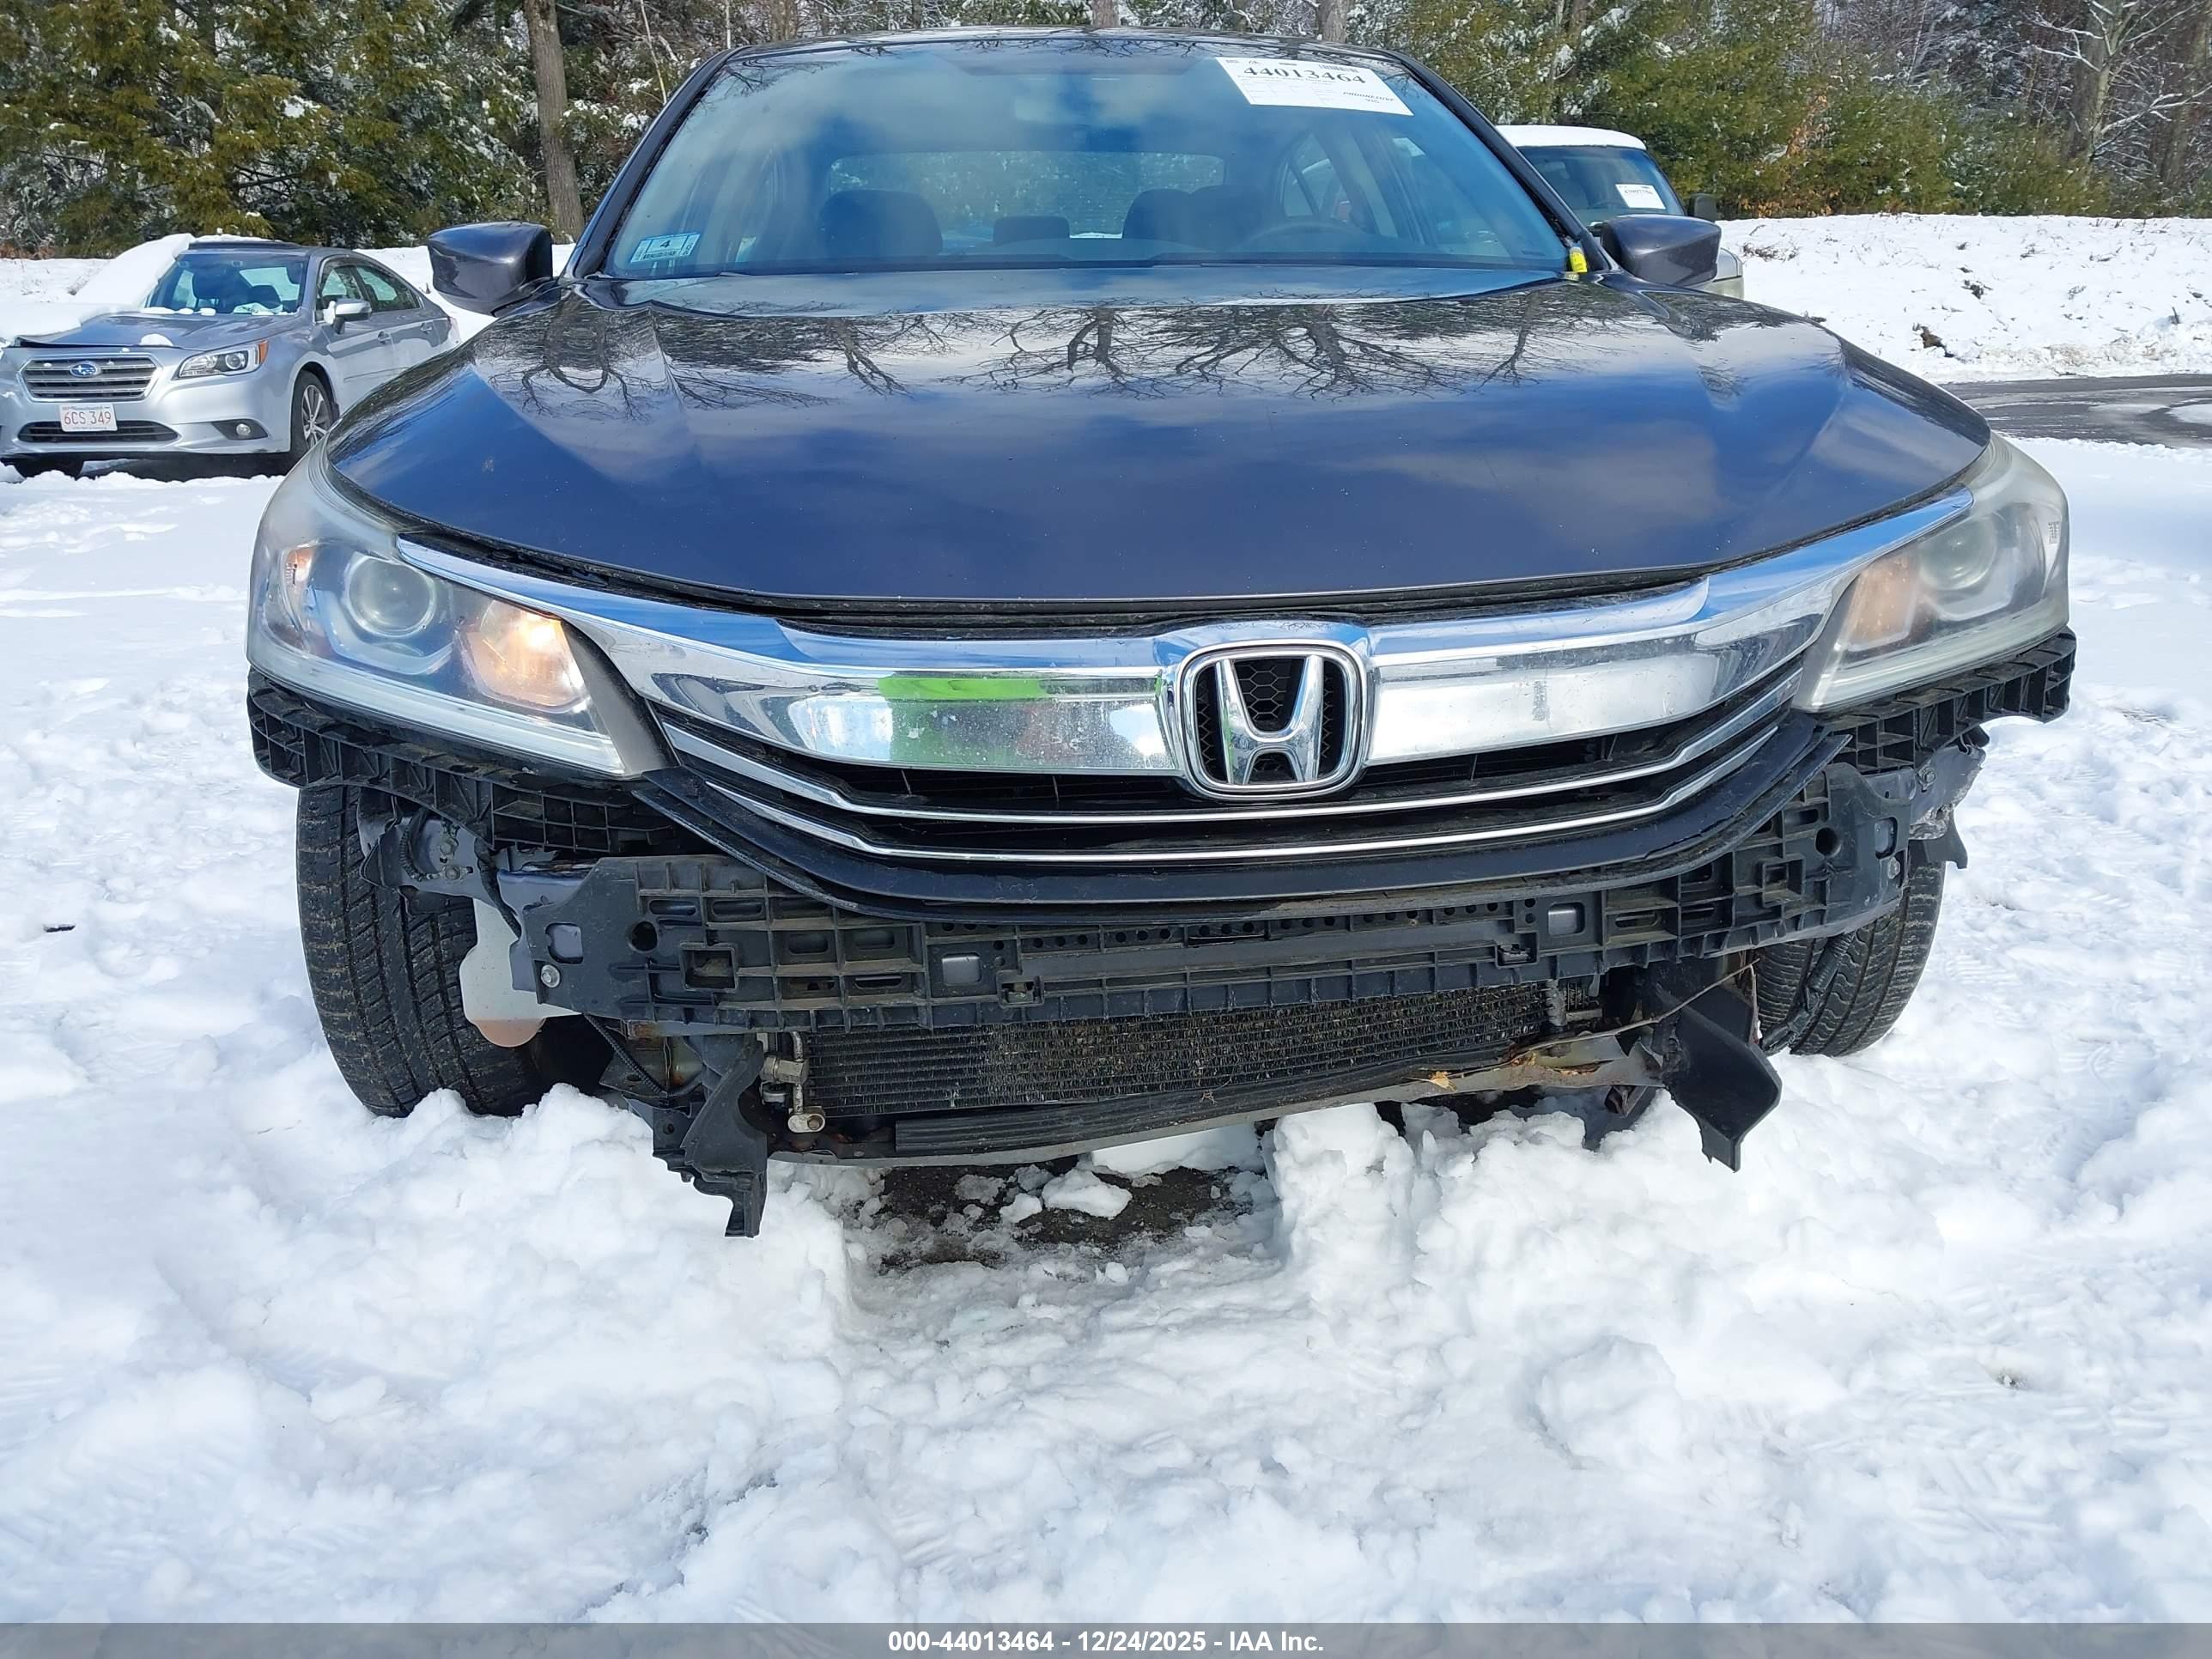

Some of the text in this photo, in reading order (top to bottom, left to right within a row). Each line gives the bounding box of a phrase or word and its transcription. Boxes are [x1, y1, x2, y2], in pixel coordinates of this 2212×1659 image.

[1243, 66, 1366, 84] 44013464
[660, 240, 672, 248] 4
[64, 410, 112, 425] 6CS 349
